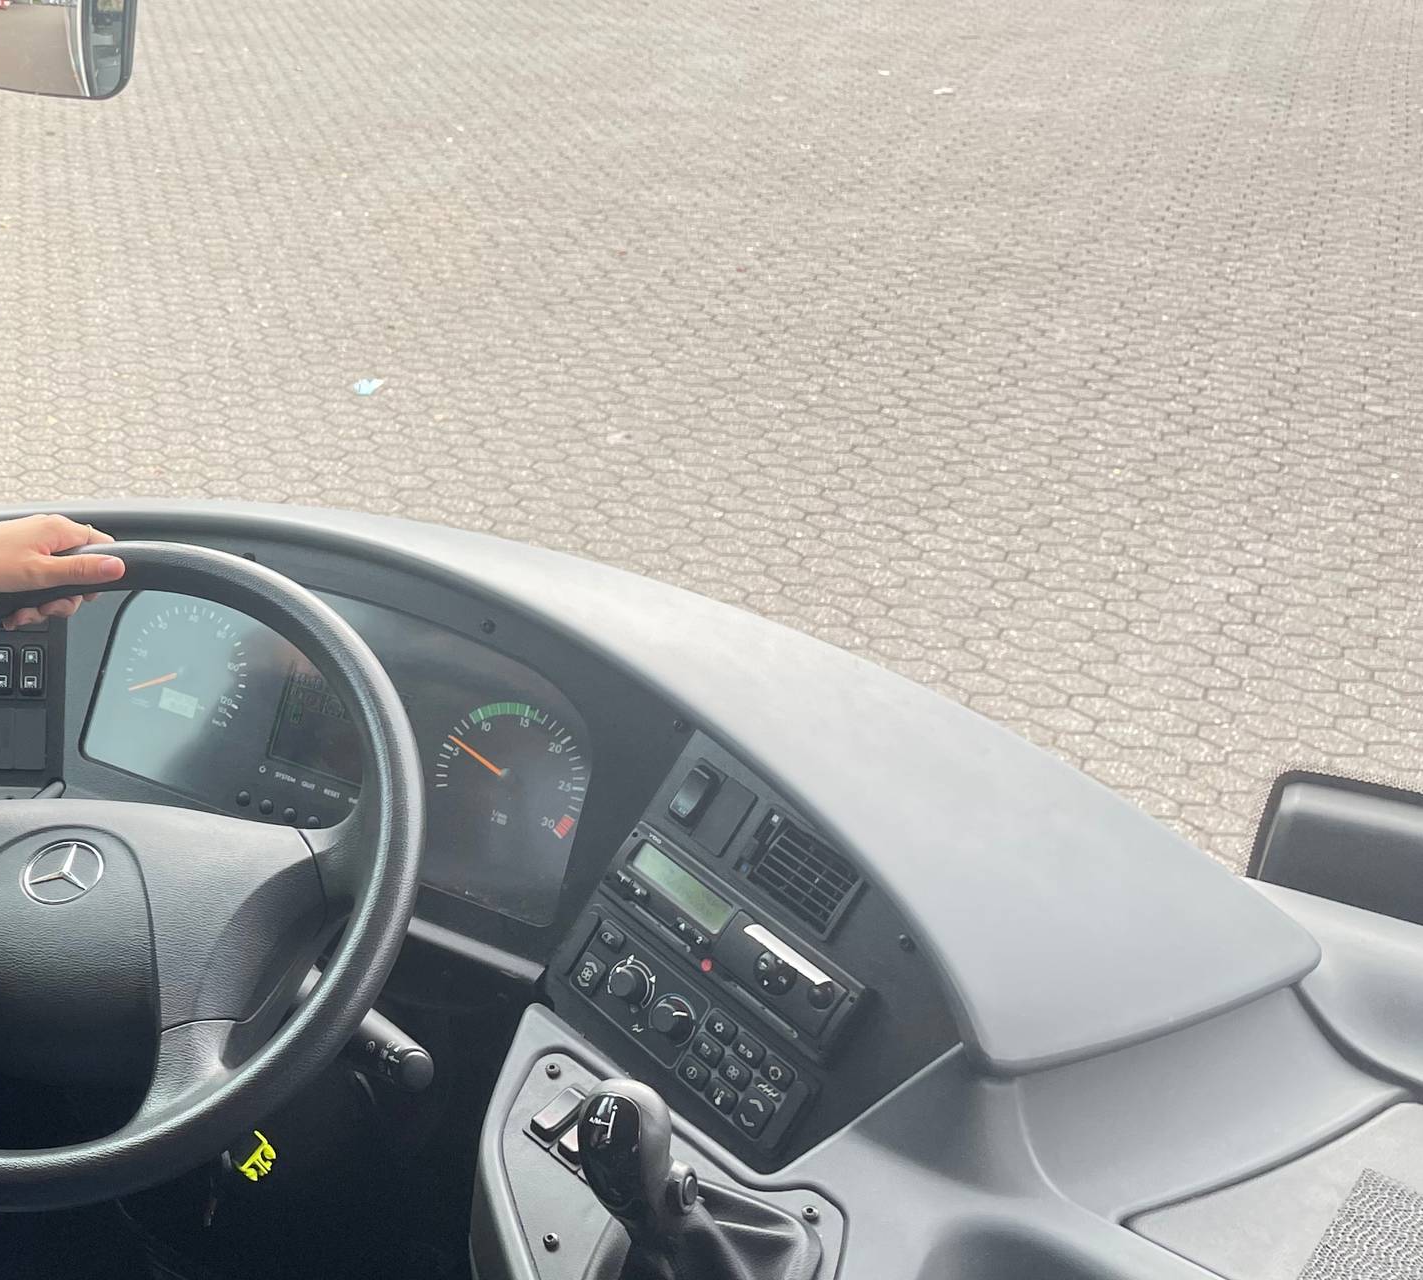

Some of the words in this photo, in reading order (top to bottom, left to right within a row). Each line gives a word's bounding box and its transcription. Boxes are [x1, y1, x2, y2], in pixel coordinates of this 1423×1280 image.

[481, 722, 492, 732] 10
[520, 718, 530, 728] 15
[548, 743, 562, 754] 20
[558, 781, 572, 792] 25
[540, 817, 555, 829] 30
